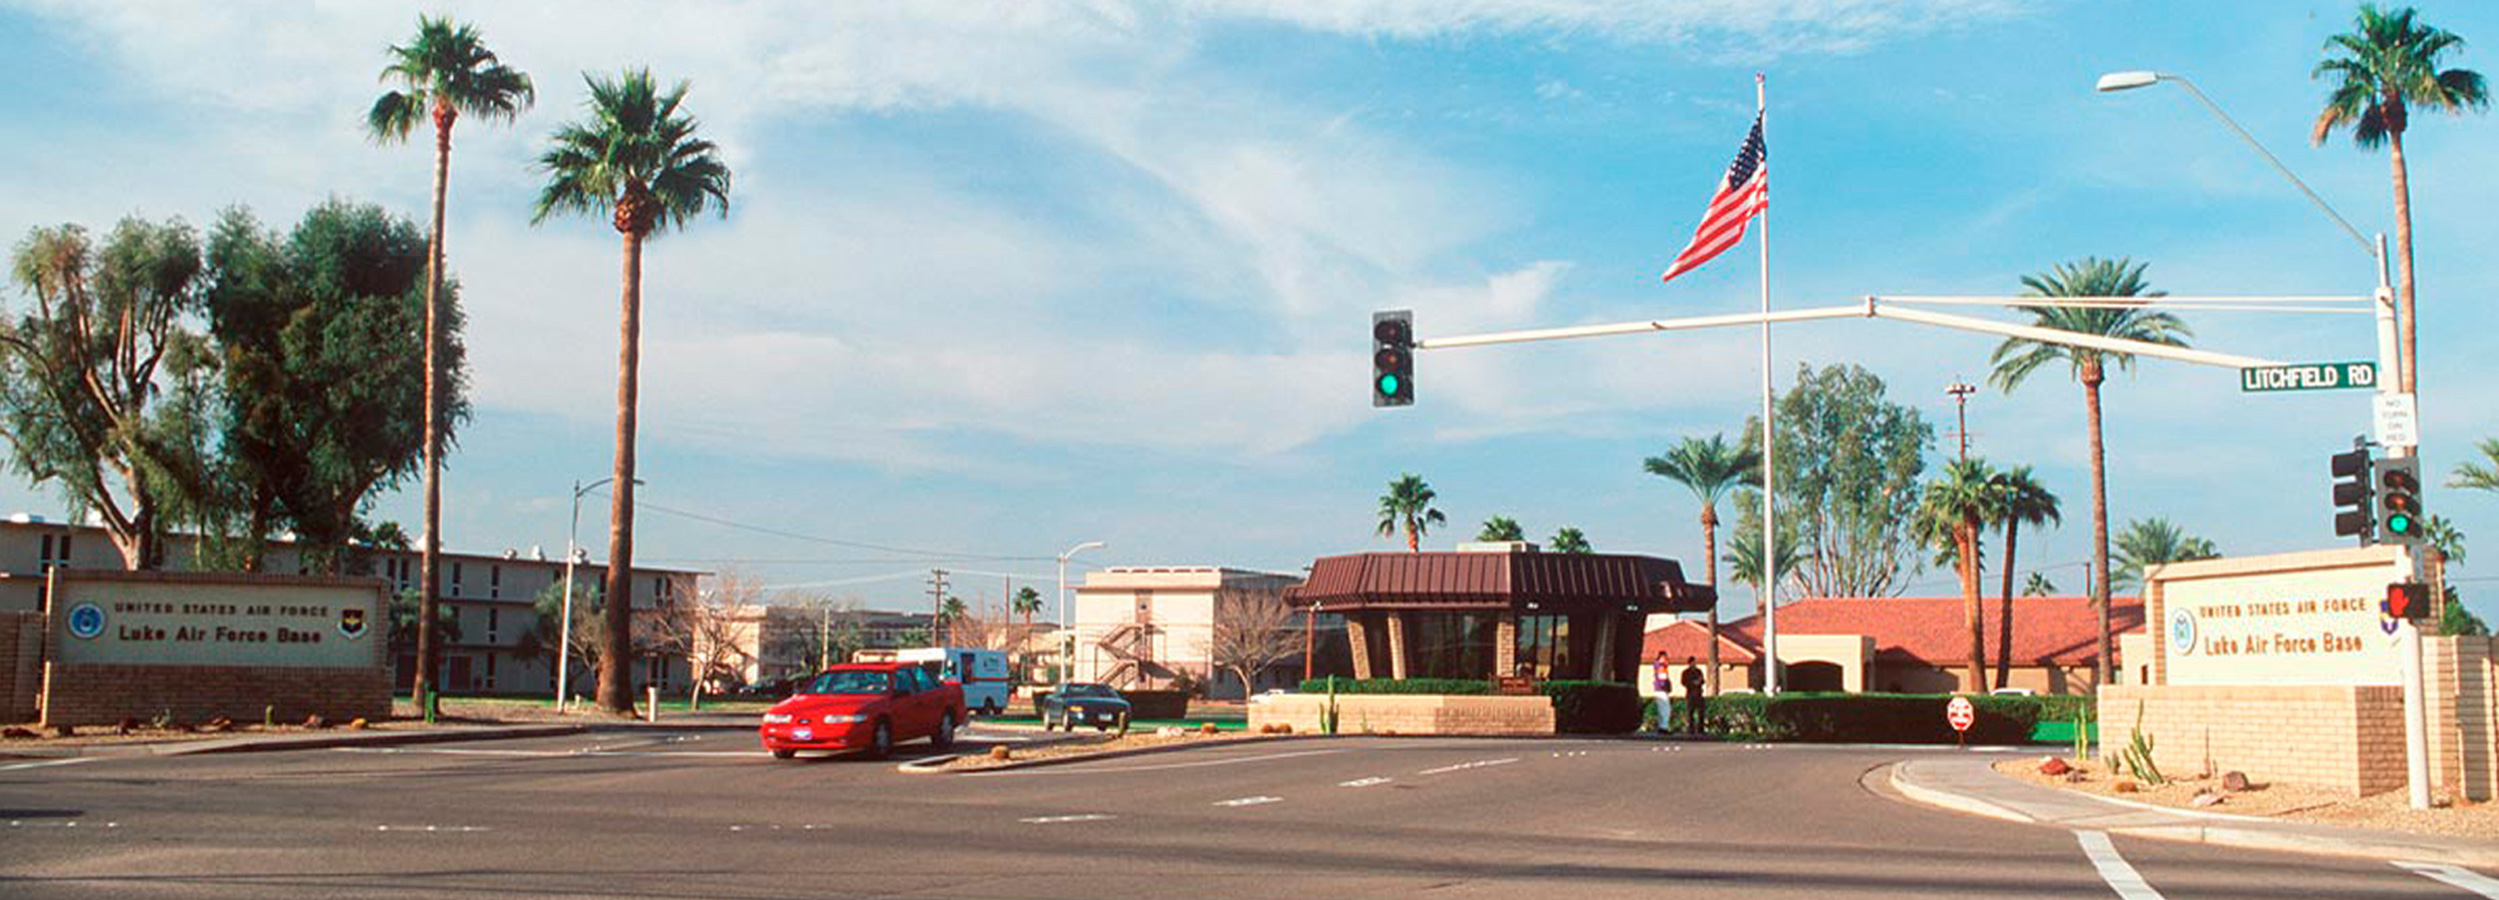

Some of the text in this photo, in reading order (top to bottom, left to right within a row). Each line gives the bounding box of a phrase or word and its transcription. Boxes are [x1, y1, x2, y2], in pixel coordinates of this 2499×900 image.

[2245, 364, 2373, 389] LITCHFIELD RD
[114, 602, 327, 617] UNITED STATES AIR FORCE
[2200, 597, 2366, 618] UNITED STATES AIR FORCE
[119, 624, 321, 643] Luke Air Force Base
[2205, 632, 2362, 656] Luke Air Force Base
